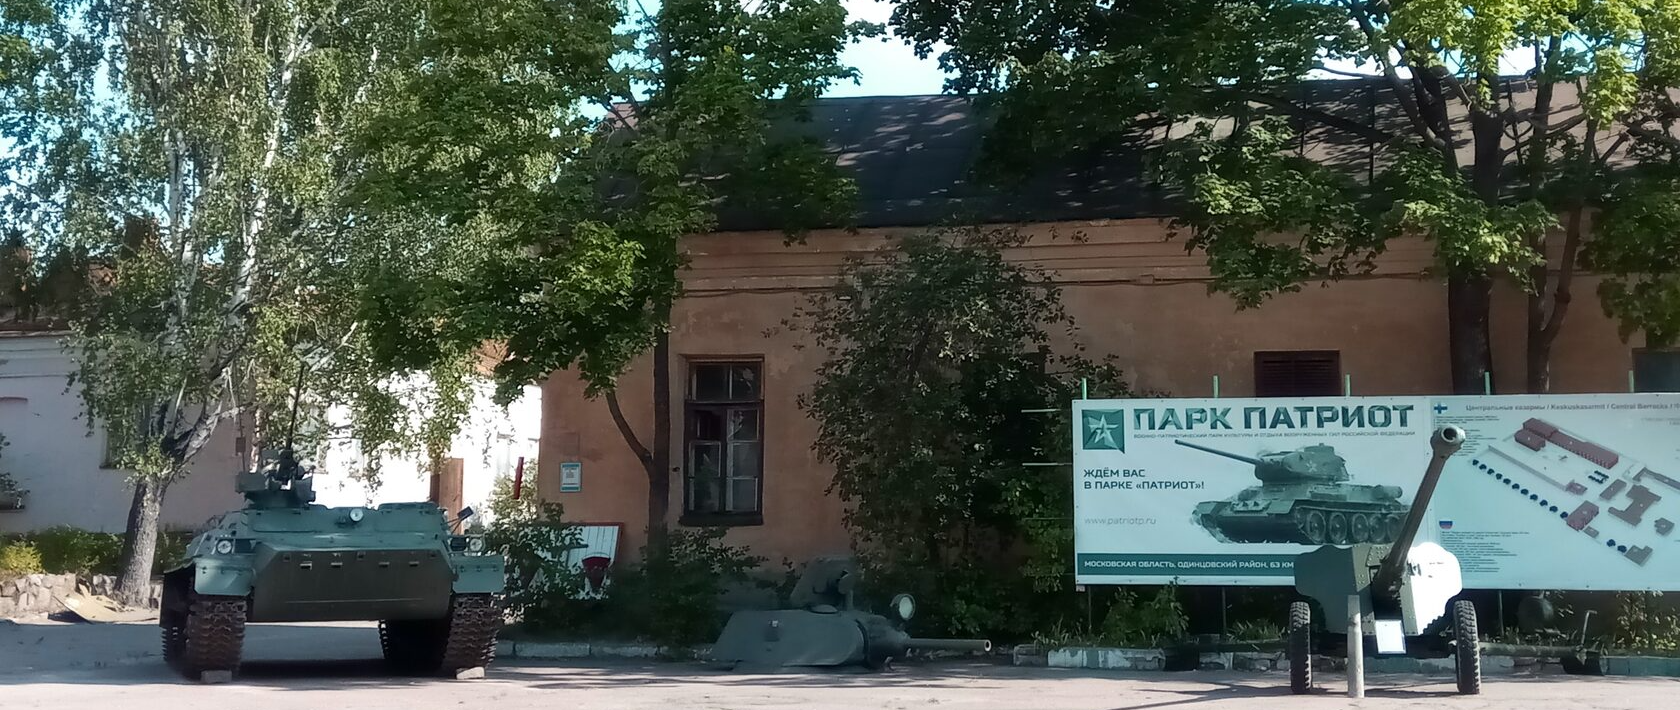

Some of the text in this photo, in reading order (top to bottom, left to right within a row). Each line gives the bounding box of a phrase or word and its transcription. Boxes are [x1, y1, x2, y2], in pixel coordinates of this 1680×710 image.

[1134, 405, 1414, 430] ПАРК ПАТРИОТ
[1084, 467, 1120, 478] ЖДЁМ
[1084, 481, 1204, 489] В ПАРКЕ «ПАТРИОТ»!
